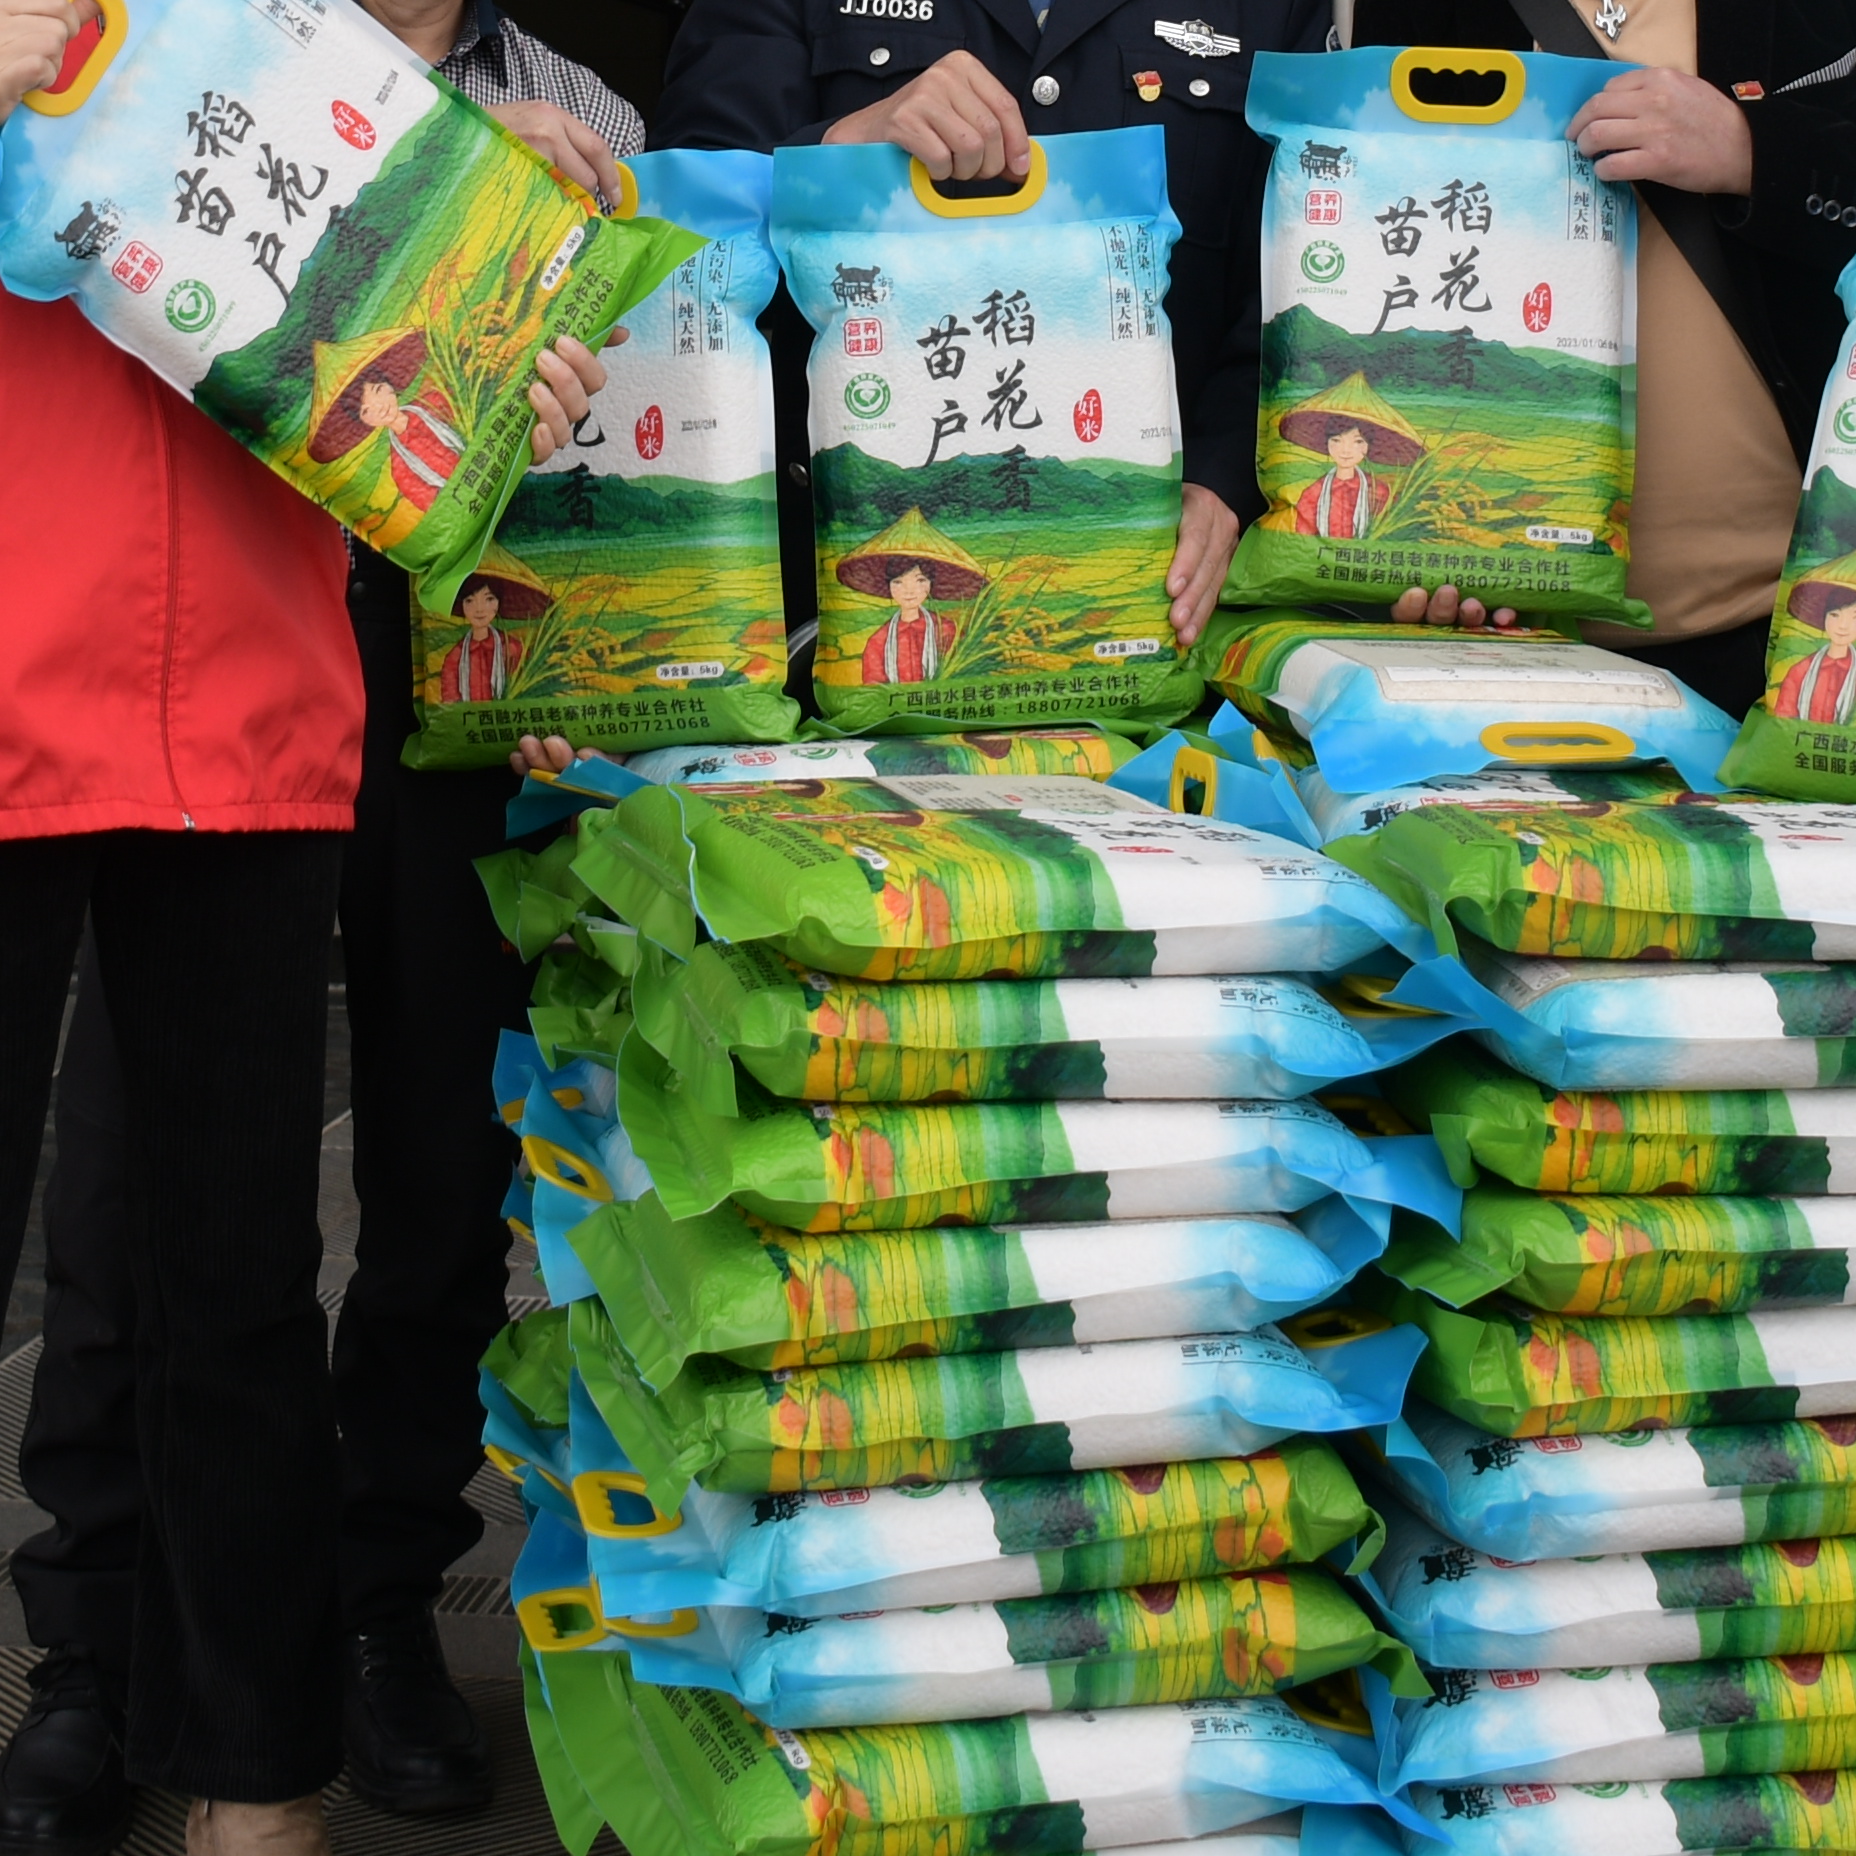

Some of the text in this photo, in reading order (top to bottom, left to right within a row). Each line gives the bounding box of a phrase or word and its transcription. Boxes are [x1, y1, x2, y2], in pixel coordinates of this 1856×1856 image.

[332, 104, 375, 149] 好米
[1430, 178, 1494, 390] 稻花香
[1527, 288, 1548, 331] 好米
[972, 288, 1044, 513] 稻花香
[1077, 395, 1100, 441] 好米
[639, 411, 661, 458] 好米
[1316, 545, 1572, 577] 广西融水县老寨种养专业合作社
[462, 696, 707, 727] 广西融水县老寨种养专业合作社
[888, 673, 1141, 708] 广西融水县老寨种养专业合作社
